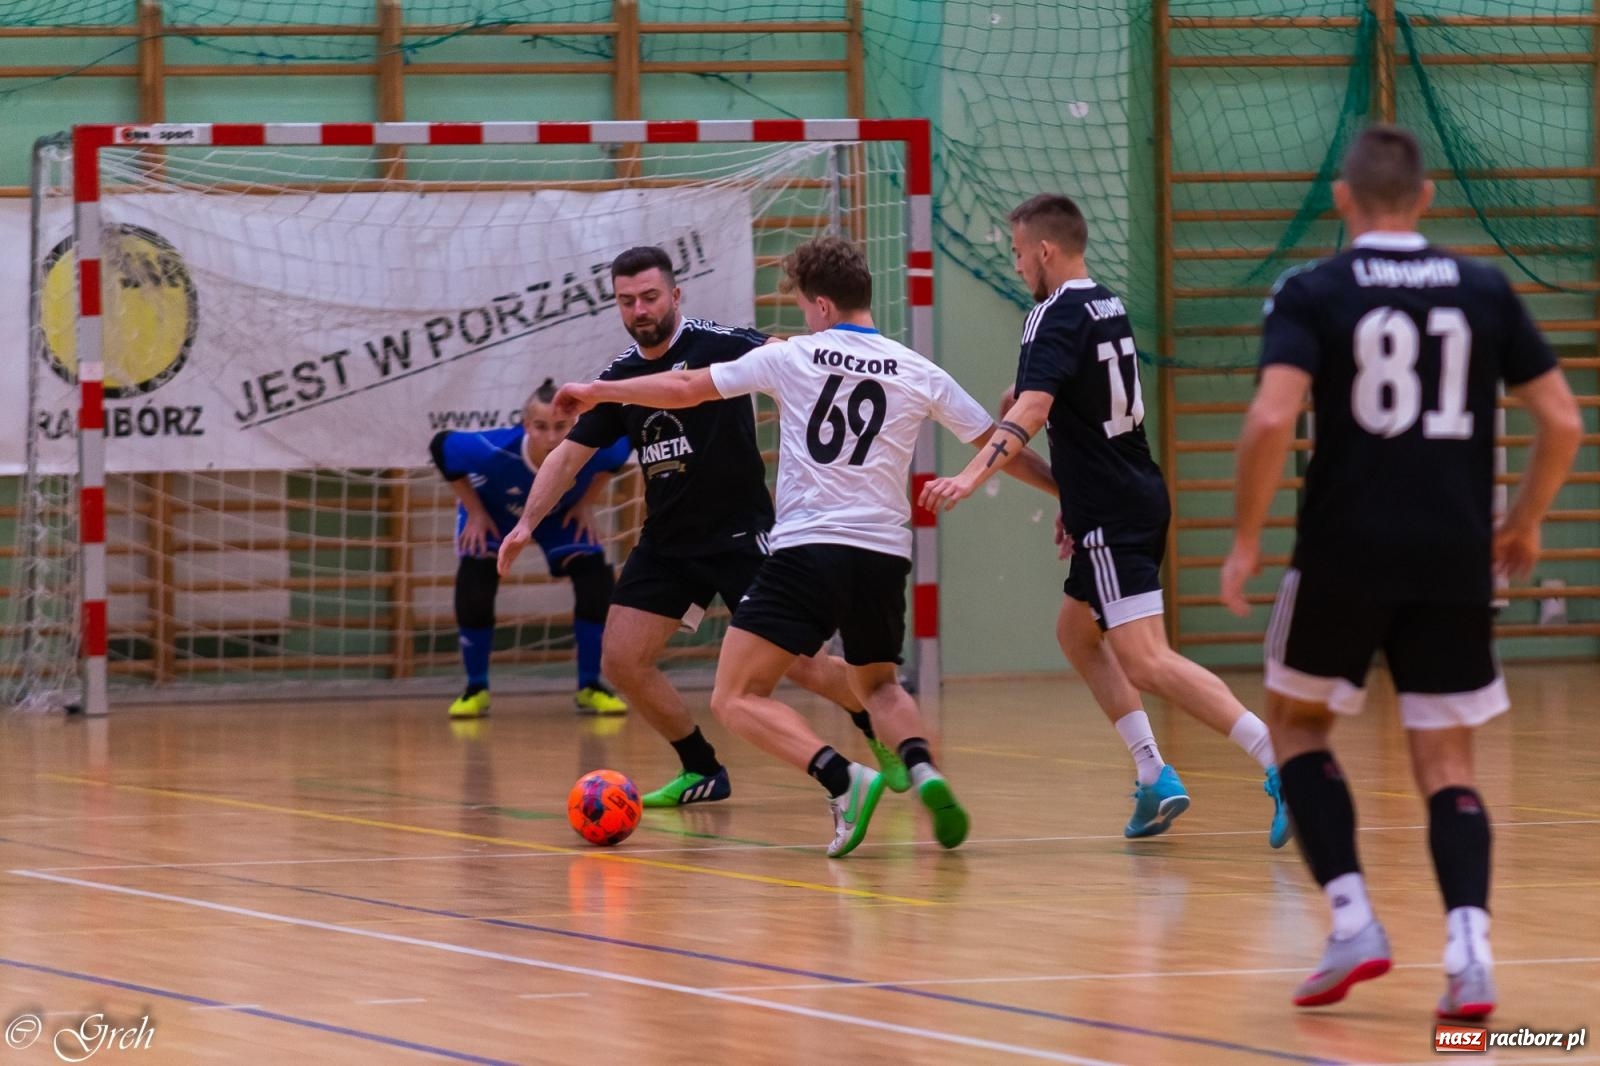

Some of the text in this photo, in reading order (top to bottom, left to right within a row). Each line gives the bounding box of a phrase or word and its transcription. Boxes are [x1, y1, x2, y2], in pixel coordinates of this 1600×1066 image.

[234, 350, 351, 424] JEST
[365, 329, 411, 377] W
[813, 348, 898, 376] KOCZOR
[1351, 306, 1474, 439] 81
[37, 399, 204, 438] RAIBÓRZ
[806, 374, 887, 466] 69
